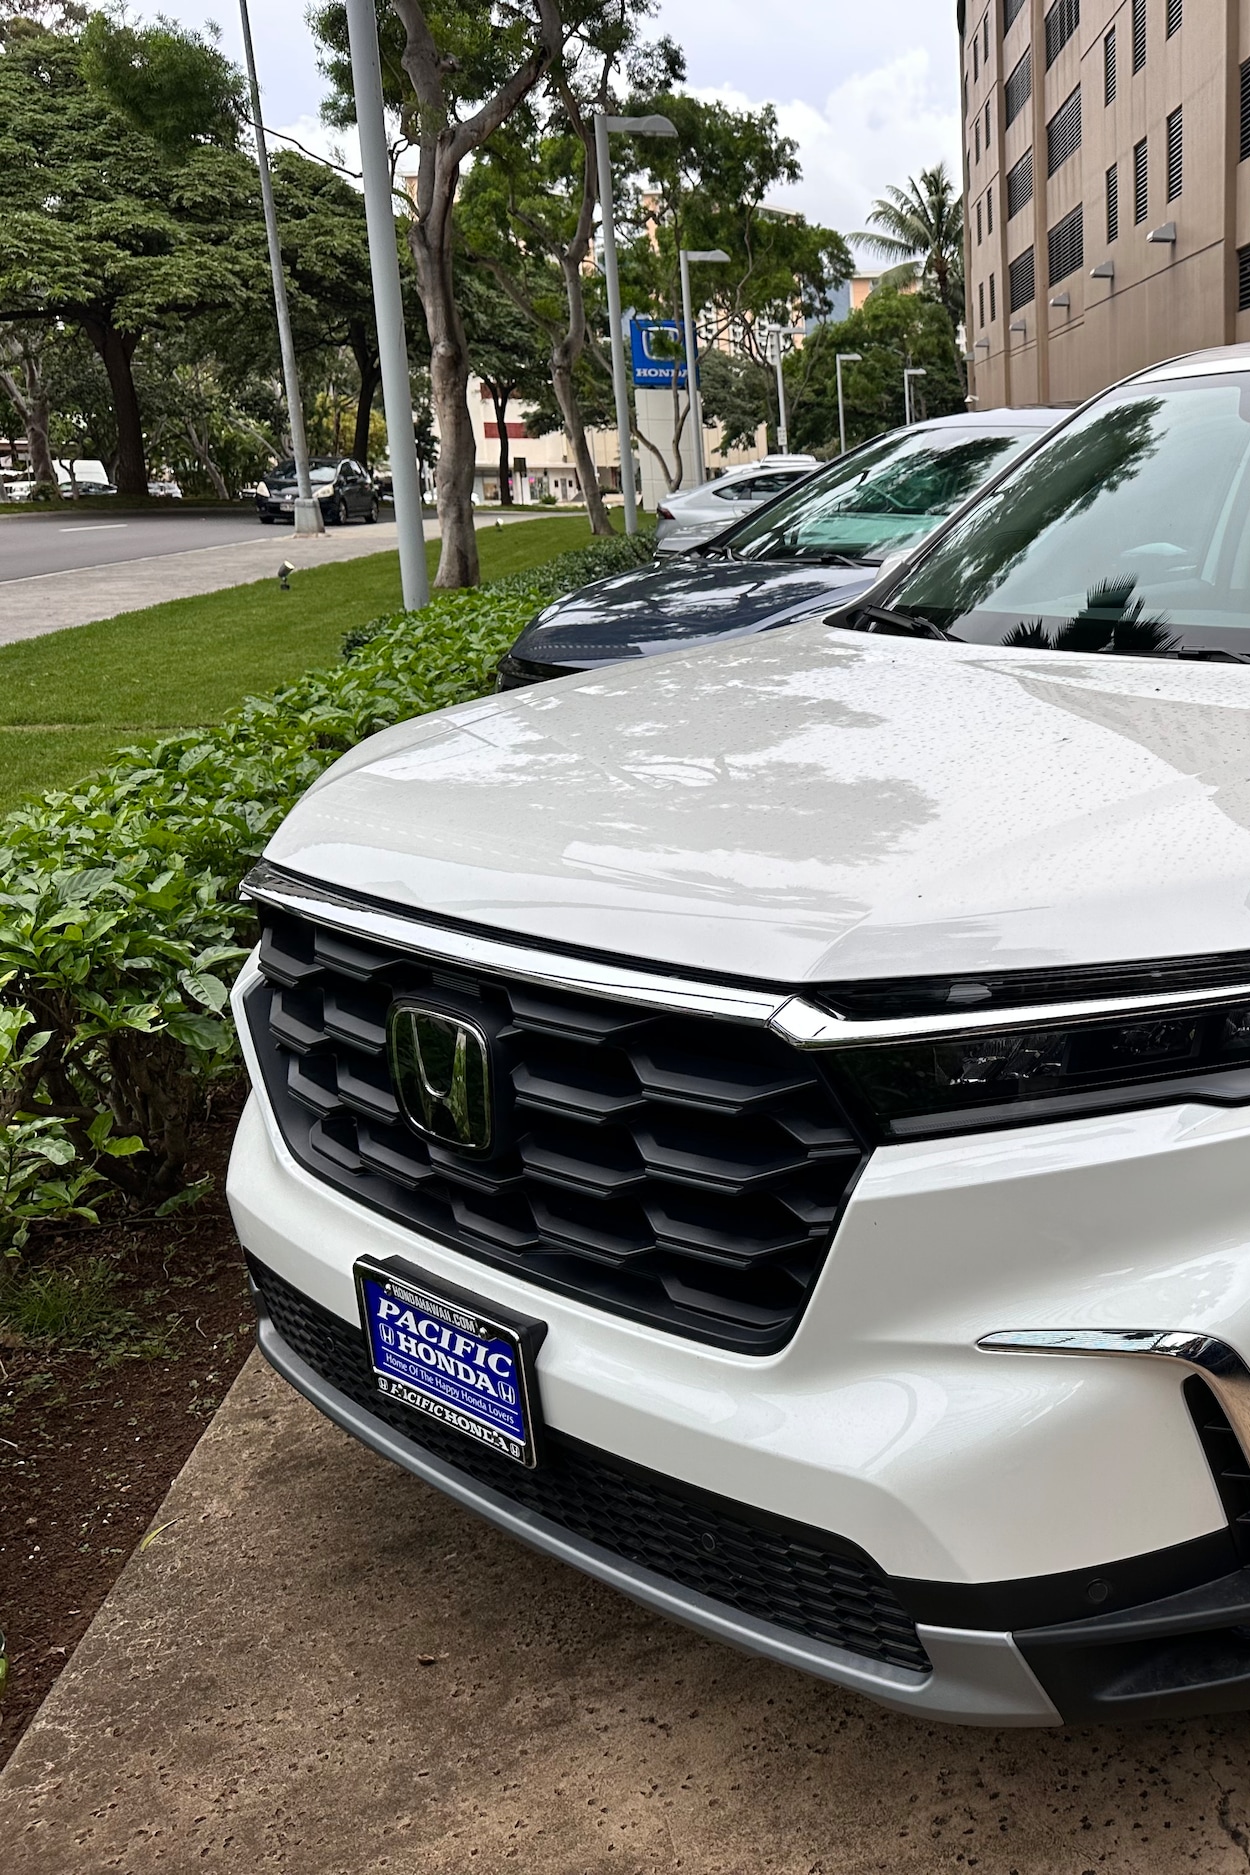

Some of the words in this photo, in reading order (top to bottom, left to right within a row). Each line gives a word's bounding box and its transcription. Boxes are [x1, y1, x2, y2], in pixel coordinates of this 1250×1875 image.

[377, 1297, 512, 1377] PACIFIC
[397, 1331, 498, 1397] HONDA
[385, 1352, 408, 1371] Home
[409, 1364, 419, 1376] Of
[420, 1369, 434, 1384] The
[435, 1376, 460, 1399] Happy
[461, 1389, 487, 1411] Honda
[488, 1403, 514, 1424] Lovers
